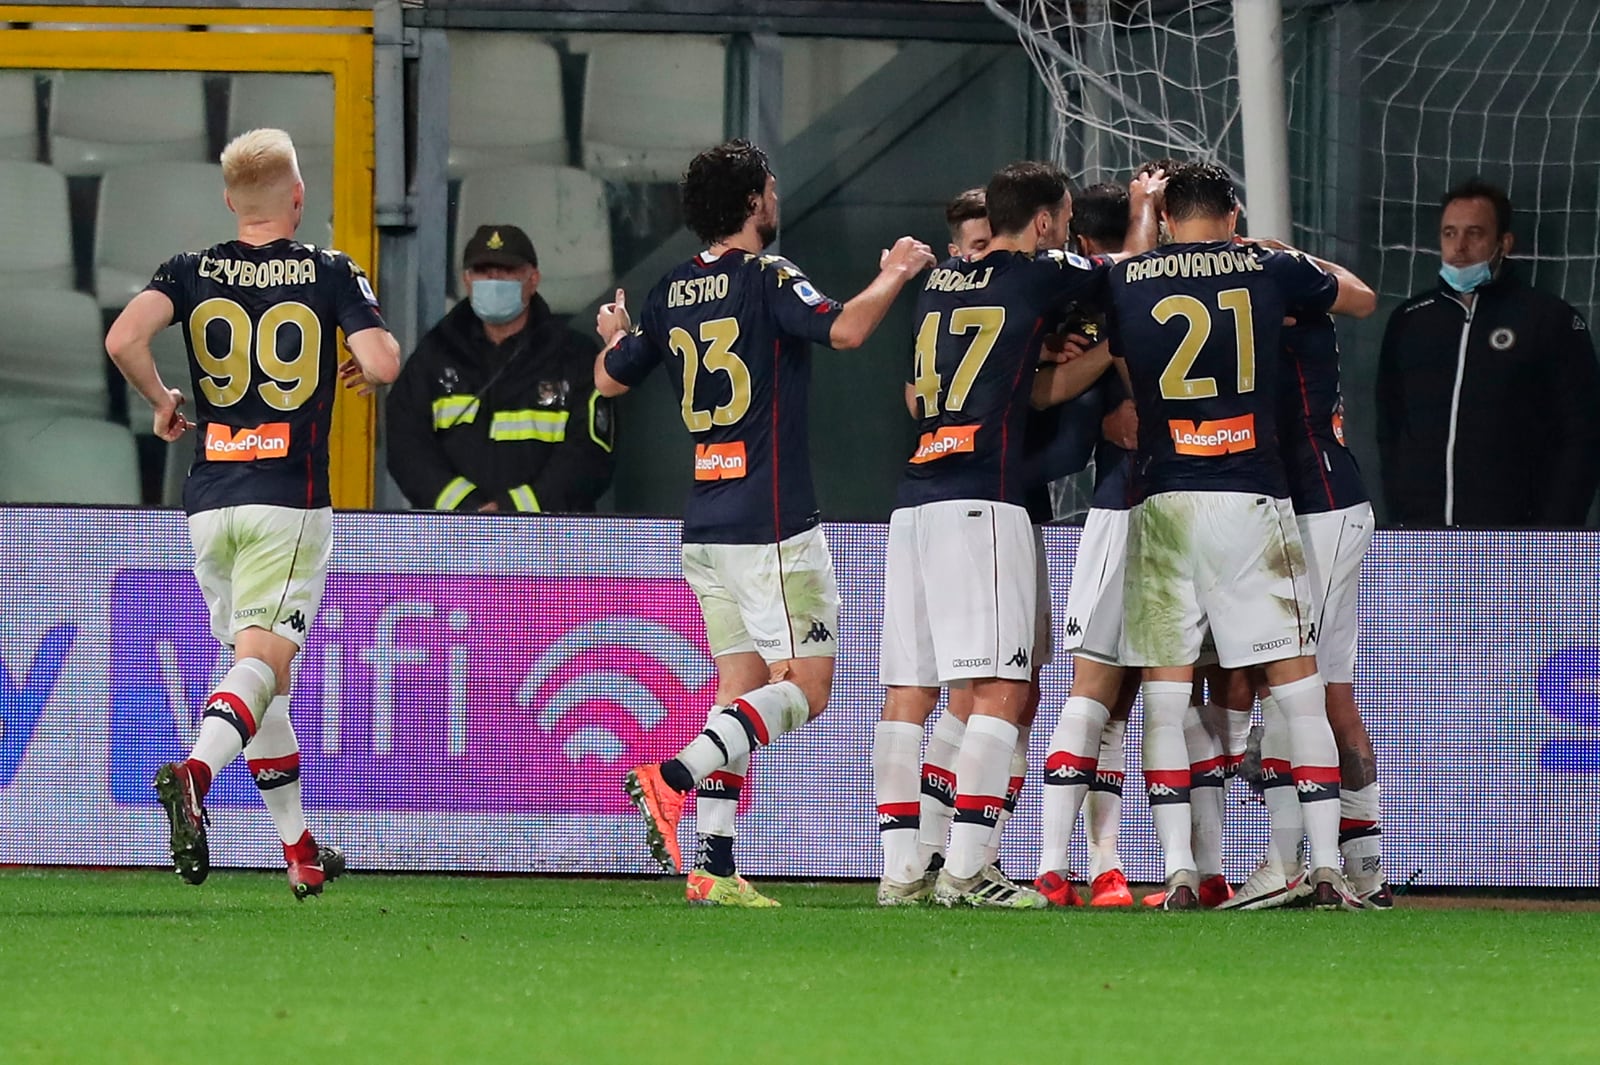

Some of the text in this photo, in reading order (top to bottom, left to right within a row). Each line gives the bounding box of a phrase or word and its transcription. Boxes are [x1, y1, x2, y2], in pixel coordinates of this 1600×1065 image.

[198, 255, 317, 289] CZYBORRA
[667, 273, 729, 309] DESTRO
[189, 297, 322, 411] 99
[1151, 287, 1256, 400] 21
[668, 317, 751, 433] 23
[915, 306, 1005, 418] 47
[206, 434, 284, 453] LeaePlan
[1174, 428, 1250, 446] LeasePlan
[1253, 637, 1292, 652] Kappa
[953, 658, 991, 668] Kappa
[698, 777, 726, 791] NOA
[927, 772, 958, 799] GEN
[1095, 772, 1122, 788] NOA
